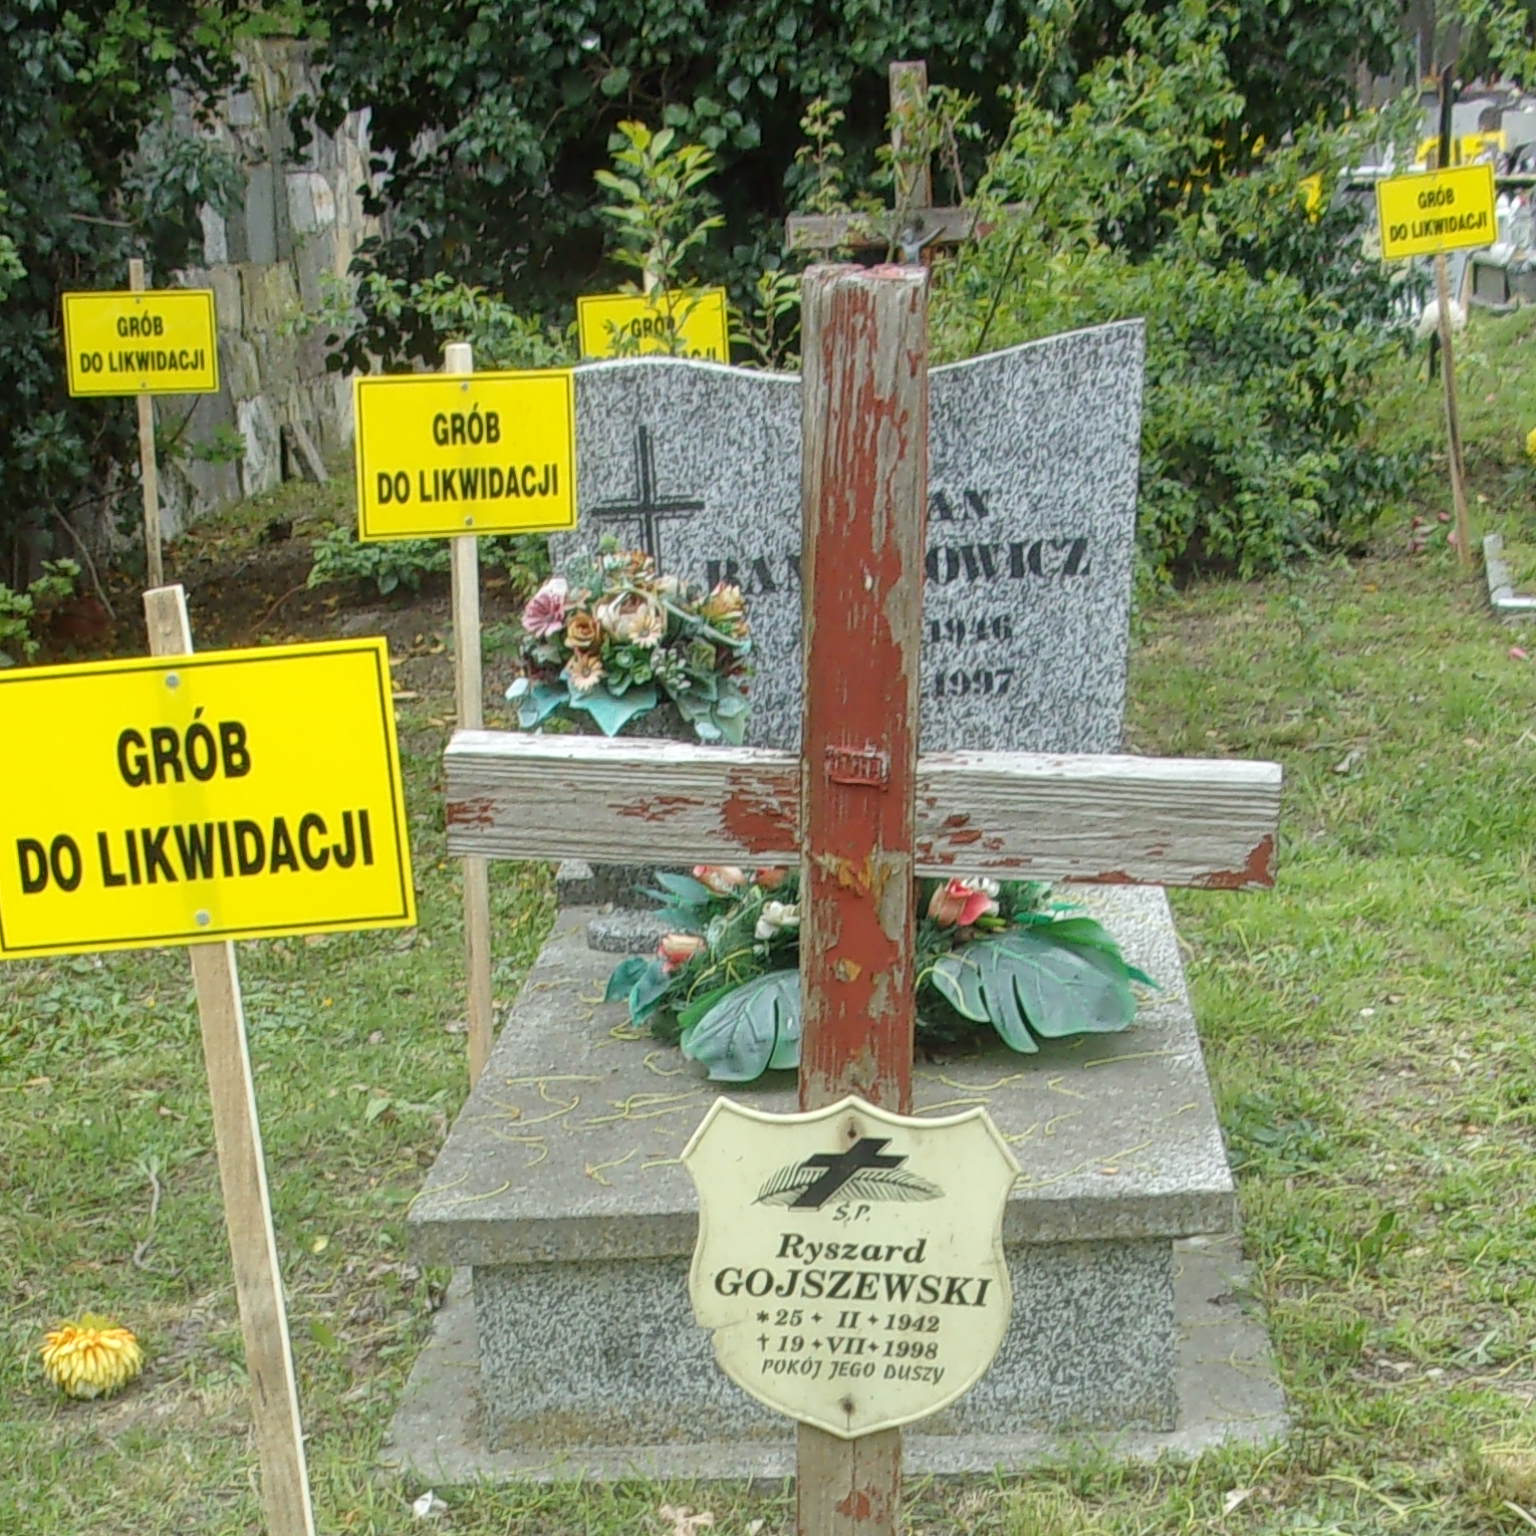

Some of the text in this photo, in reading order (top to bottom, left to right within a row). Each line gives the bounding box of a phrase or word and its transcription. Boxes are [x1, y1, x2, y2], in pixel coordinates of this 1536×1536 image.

[1417, 185, 1455, 209] GRÓB
[1389, 211, 1487, 243] DO LIKWIDACJI
[116, 311, 165, 338] GRÓB
[79, 347, 206, 375] DO LIKWIDACJI
[432, 403, 501, 446] GRÓB
[377, 464, 559, 506] DO LIKWIDACJI
[116, 707, 251, 788] GRÓB
[16, 809, 375, 895] DO LIKWIDACJI
[775, 1232, 929, 1266] Ryszard
[714, 1266, 993, 1308] GOJSZEWSKI
[836, 1311, 862, 1330] II
[884, 1313, 941, 1334] 1942
[884, 1340, 939, 1360] 1998
[762, 1356, 946, 1387] POKÓJ JEGO DUSZY
